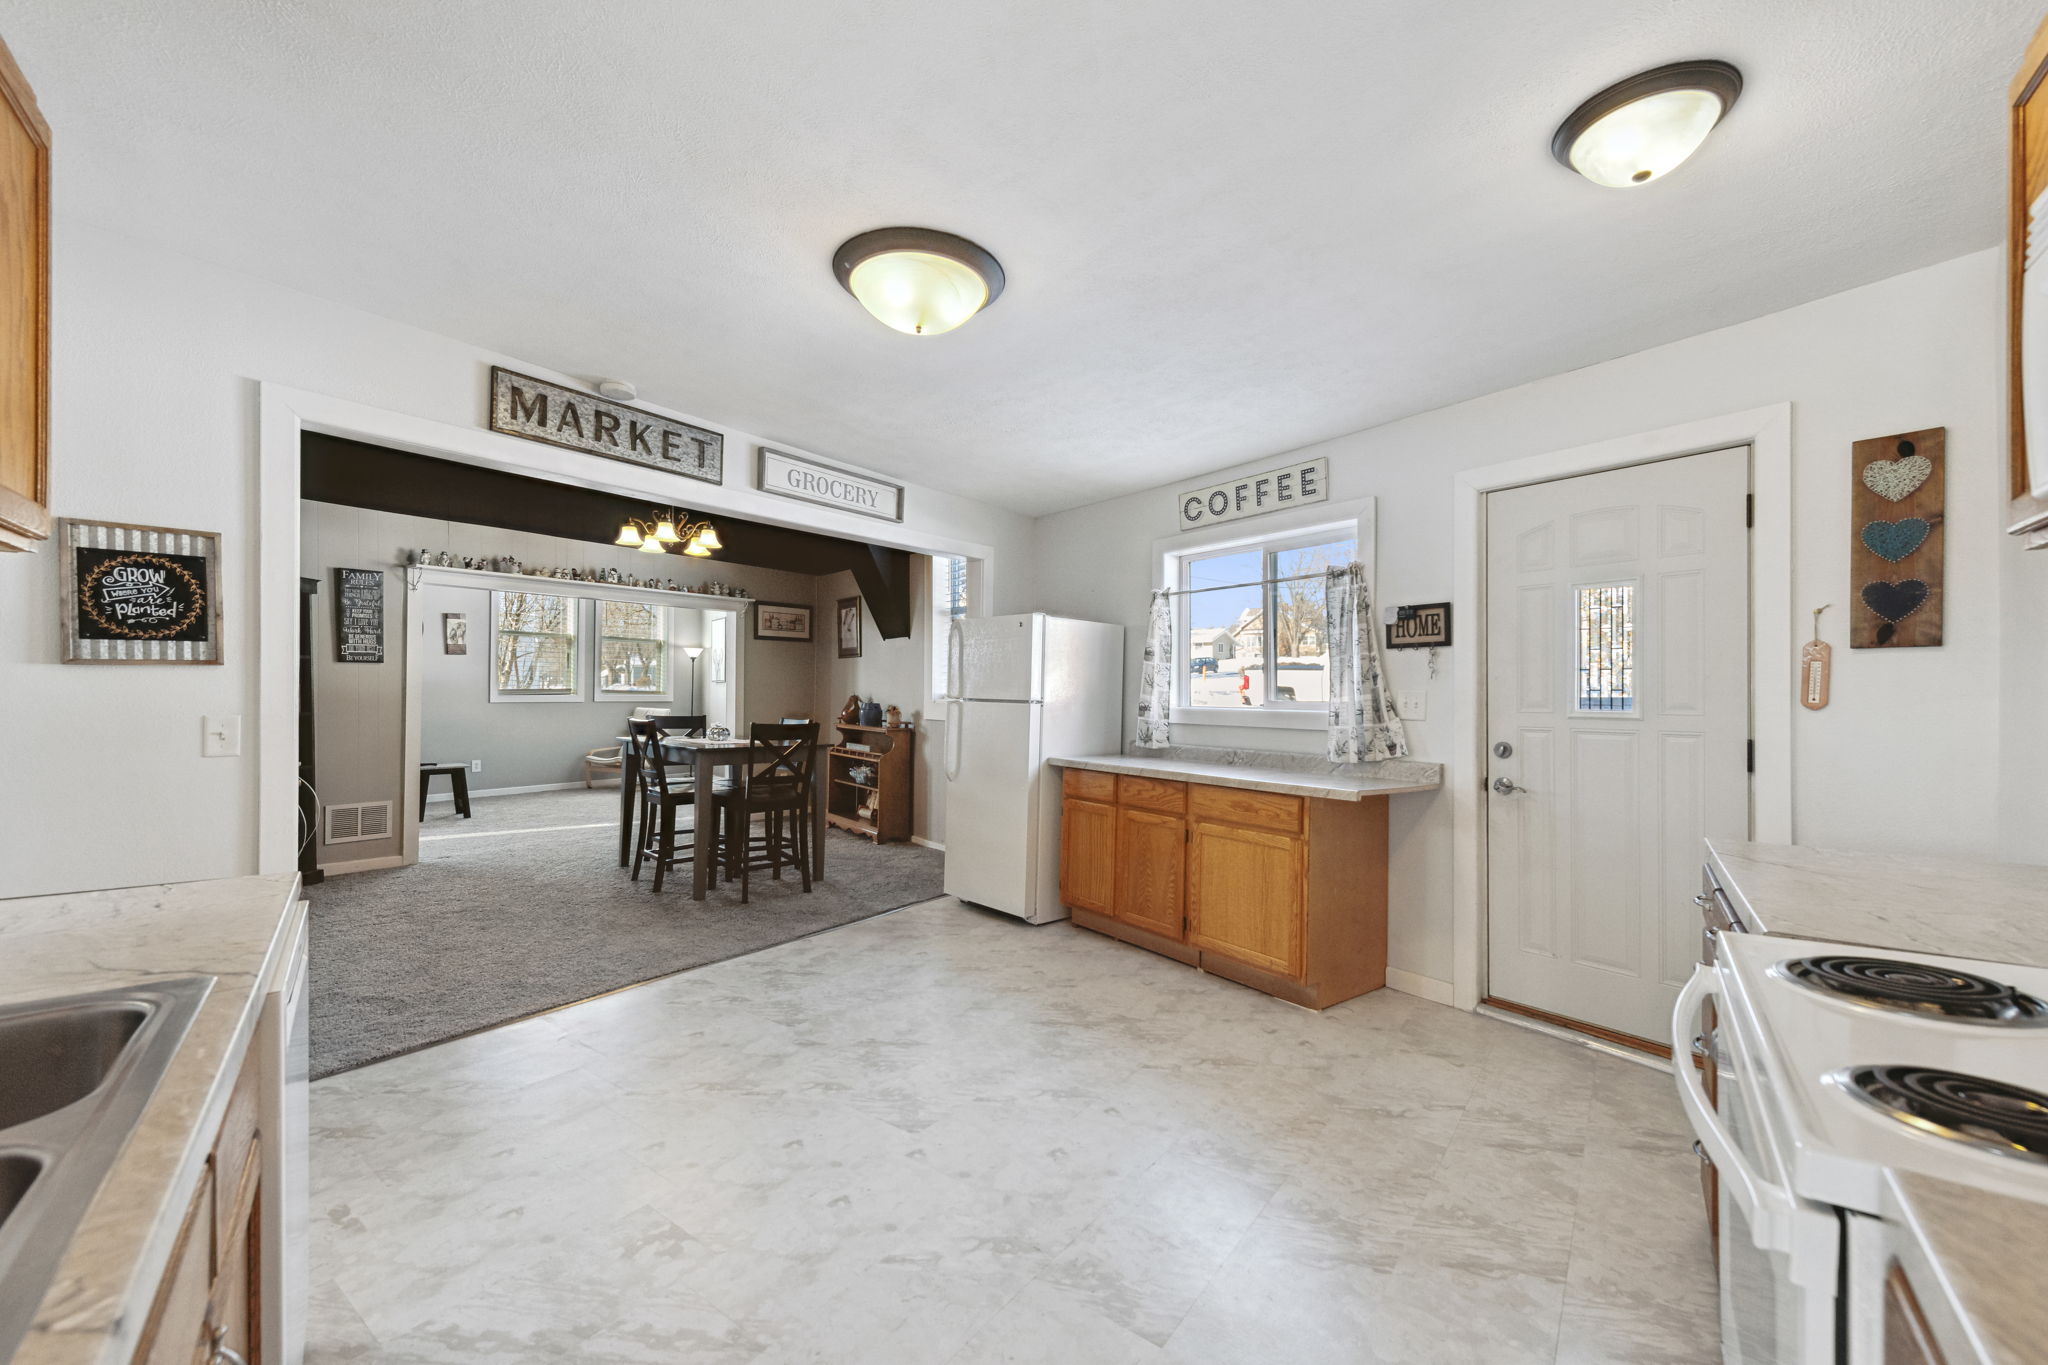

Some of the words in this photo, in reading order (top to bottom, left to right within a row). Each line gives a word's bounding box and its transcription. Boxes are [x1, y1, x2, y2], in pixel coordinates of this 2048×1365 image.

[510, 386, 713, 469] MARKET
[787, 469, 879, 508] GROCERY
[1184, 467, 1316, 521] COFFEE
[113, 566, 166, 584] GROW
[342, 570, 381, 581] FAMILY
[111, 588, 139, 597] WHERE
[141, 586, 160, 594] YOU
[137, 596, 166, 604] are
[1395, 613, 1441, 638] HOME
